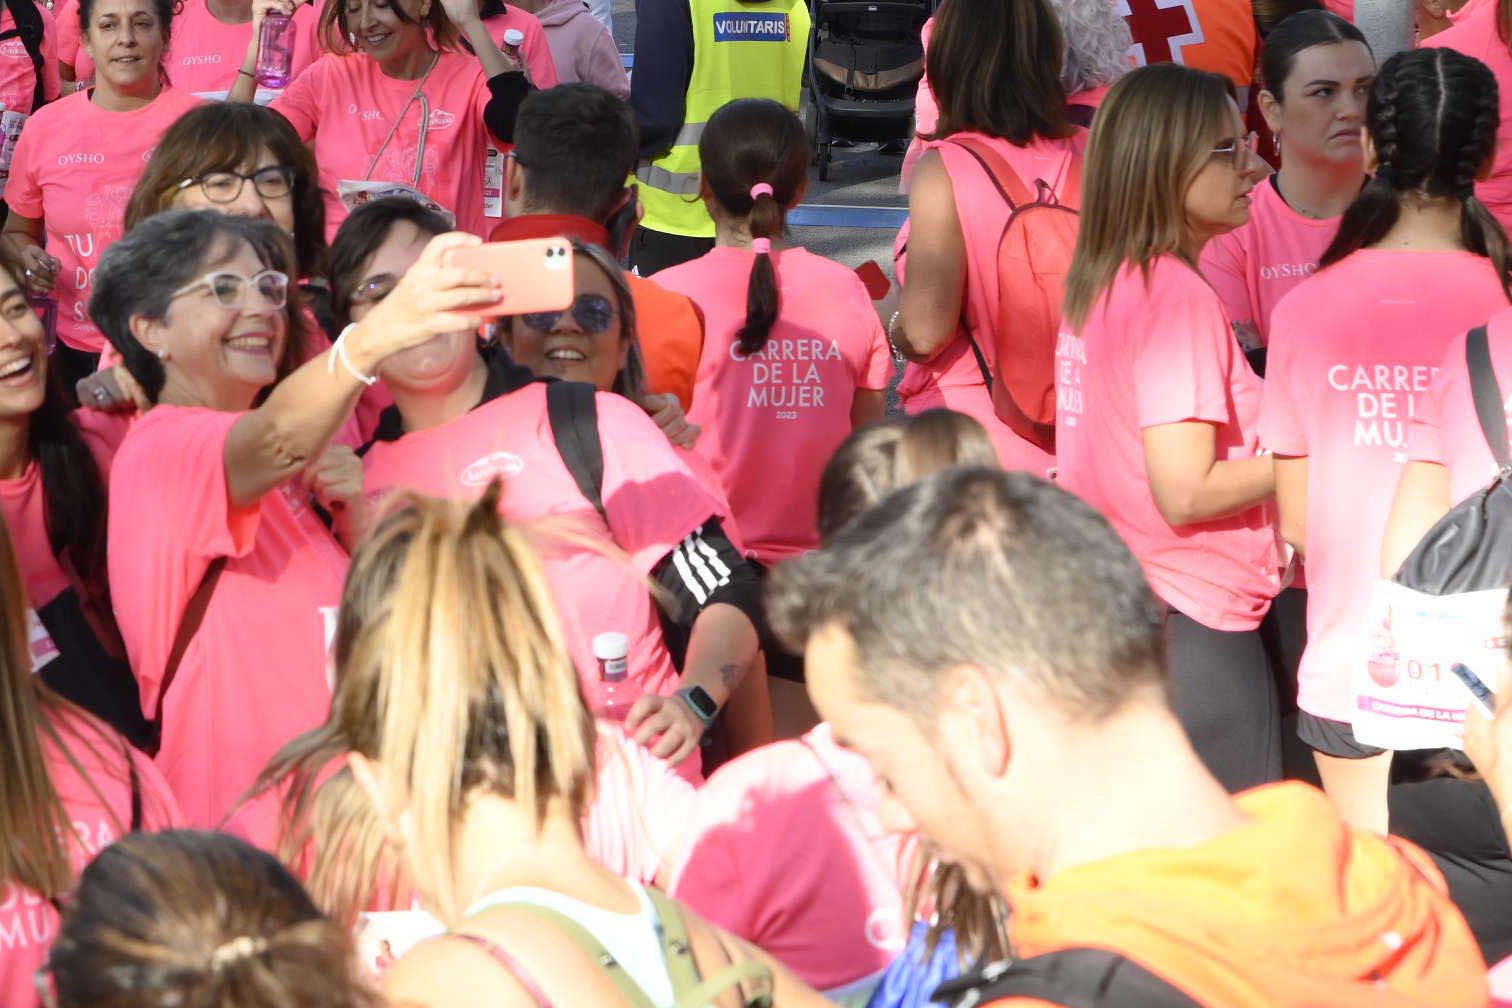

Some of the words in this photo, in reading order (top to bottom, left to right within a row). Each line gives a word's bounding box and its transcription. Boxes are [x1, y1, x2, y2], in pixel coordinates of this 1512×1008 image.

[716, 20, 785, 34] VOLUNTARIS
[182, 54, 221, 66] OYSHO
[57, 152, 105, 166] OYSHO
[64, 232, 95, 257] TU
[729, 338, 842, 363] CARRERA
[752, 363, 782, 384] DE
[791, 363, 821, 384] LA
[746, 386, 825, 408] MUJER
[1357, 393, 1398, 418] DE
[1407, 659, 1441, 683] 01
